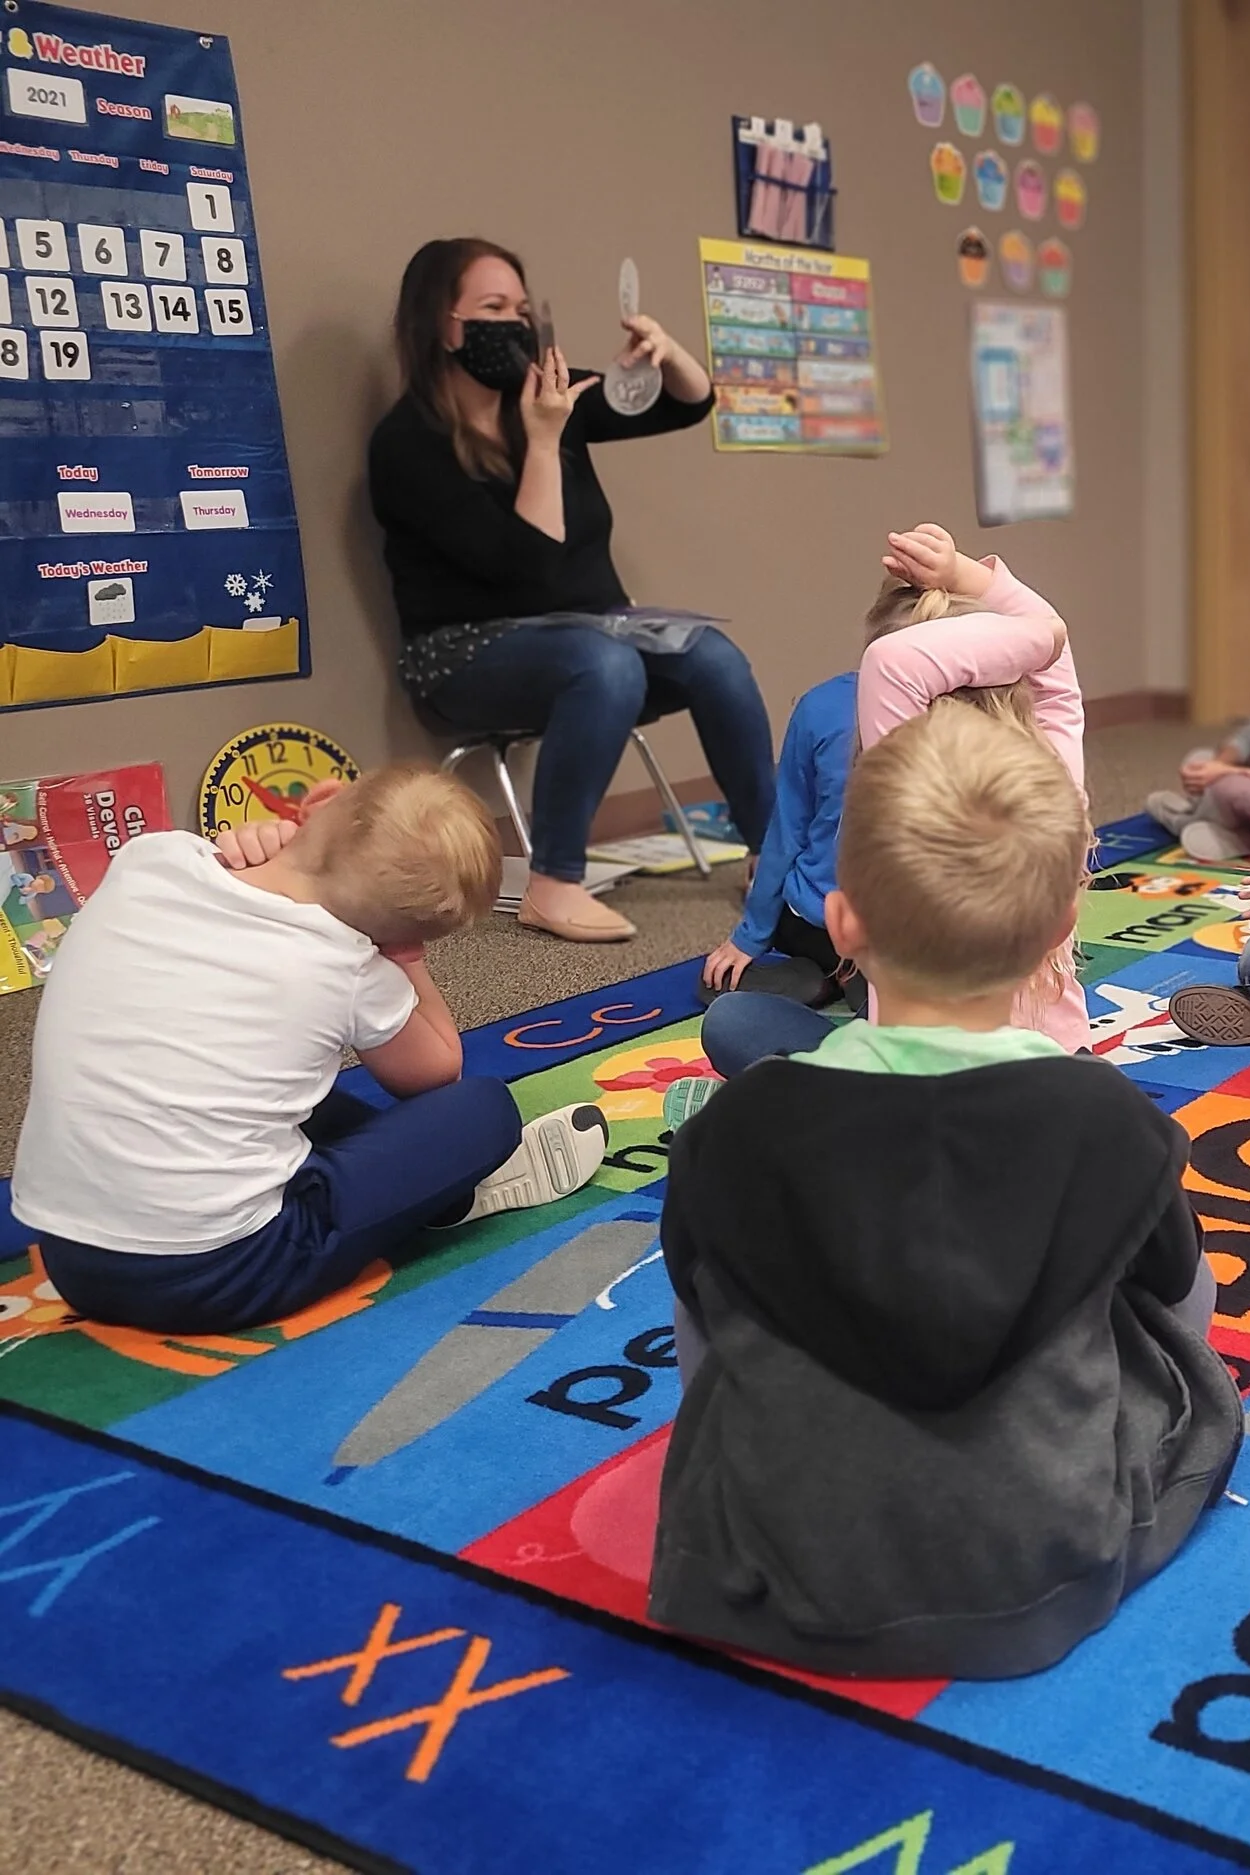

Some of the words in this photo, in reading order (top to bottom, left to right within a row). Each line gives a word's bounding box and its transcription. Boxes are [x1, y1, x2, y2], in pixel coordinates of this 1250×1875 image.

[33, 33, 145, 77] Weather
[27, 87, 67, 107] 2021
[97, 98, 152, 119] Season
[69, 150, 118, 168] Thursday
[140, 159, 169, 175] Friday
[190, 166, 234, 183] Saturday
[205, 194, 217, 220] 1
[35, 231, 52, 259] 5
[95, 238, 112, 265] 6
[155, 242, 171, 267] 7
[217, 248, 233, 273] 8
[35, 288, 70, 316] 12
[110, 292, 143, 320] 13
[159, 296, 191, 322] 14
[214, 299, 243, 324] 15
[50, 341, 79, 368] 19
[58, 465, 98, 481] Today
[188, 465, 249, 479] Tomorrow
[65, 508, 128, 520] Wednesday
[193, 505, 236, 517] Thursday
[38, 562, 89, 578] Today's
[92, 560, 147, 575] Weather
[241, 754, 258, 776] 11
[266, 742, 288, 764] 12
[303, 746, 312, 767] 1
[220, 783, 244, 807] 10
[40, 809, 50, 834] Control
[86, 805, 99, 839] Visuals
[125, 806, 146, 838] Ch
[1104, 902, 1221, 944] man
[525, 1325, 679, 1430] pe
